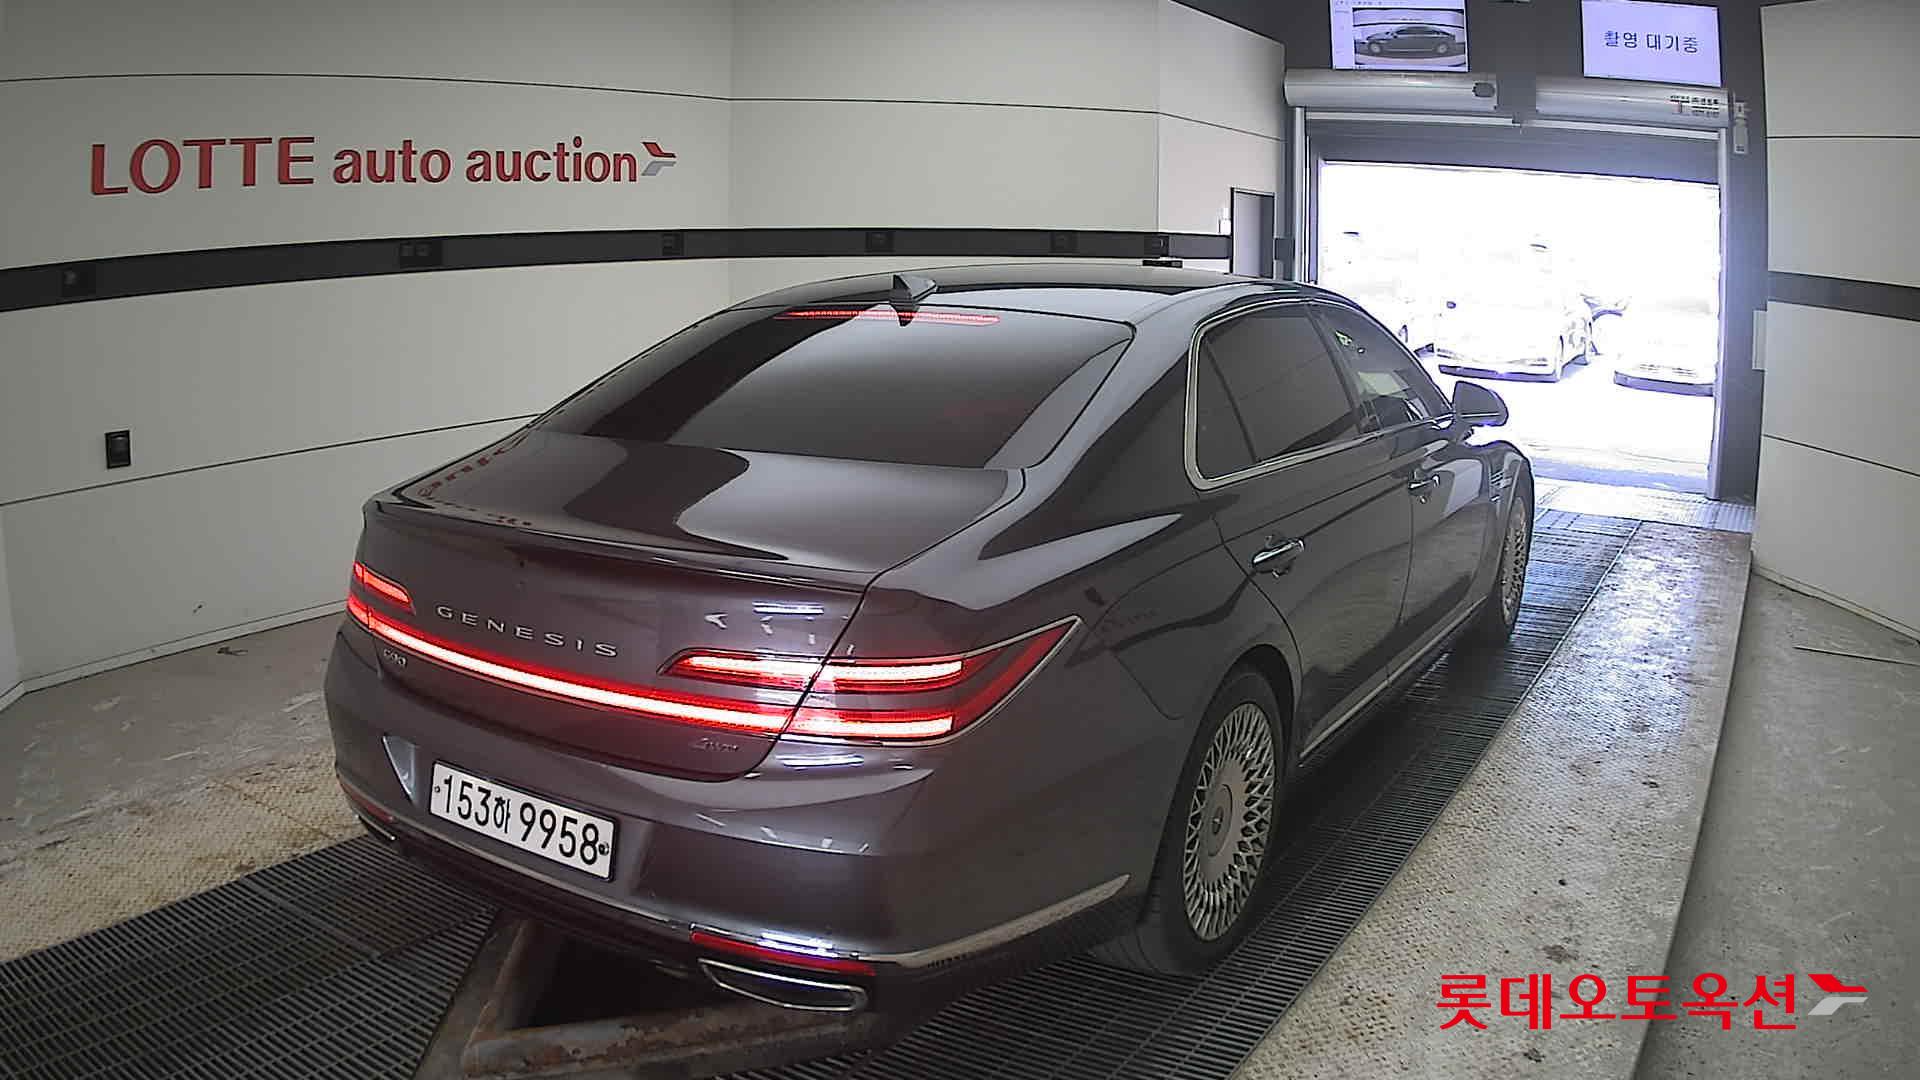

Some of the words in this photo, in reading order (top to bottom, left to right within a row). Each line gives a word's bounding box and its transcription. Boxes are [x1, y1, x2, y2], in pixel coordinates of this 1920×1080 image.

[1604, 31, 1637, 48] 촬영
[1646, 34, 1698, 53] 대기중
[91, 136, 315, 195] LOTTE
[333, 139, 451, 184] auto
[465, 136, 638, 183] auction
[437, 605, 618, 657] GENESIS
[444, 775, 511, 834] 153하
[520, 802, 599, 865] 9958
